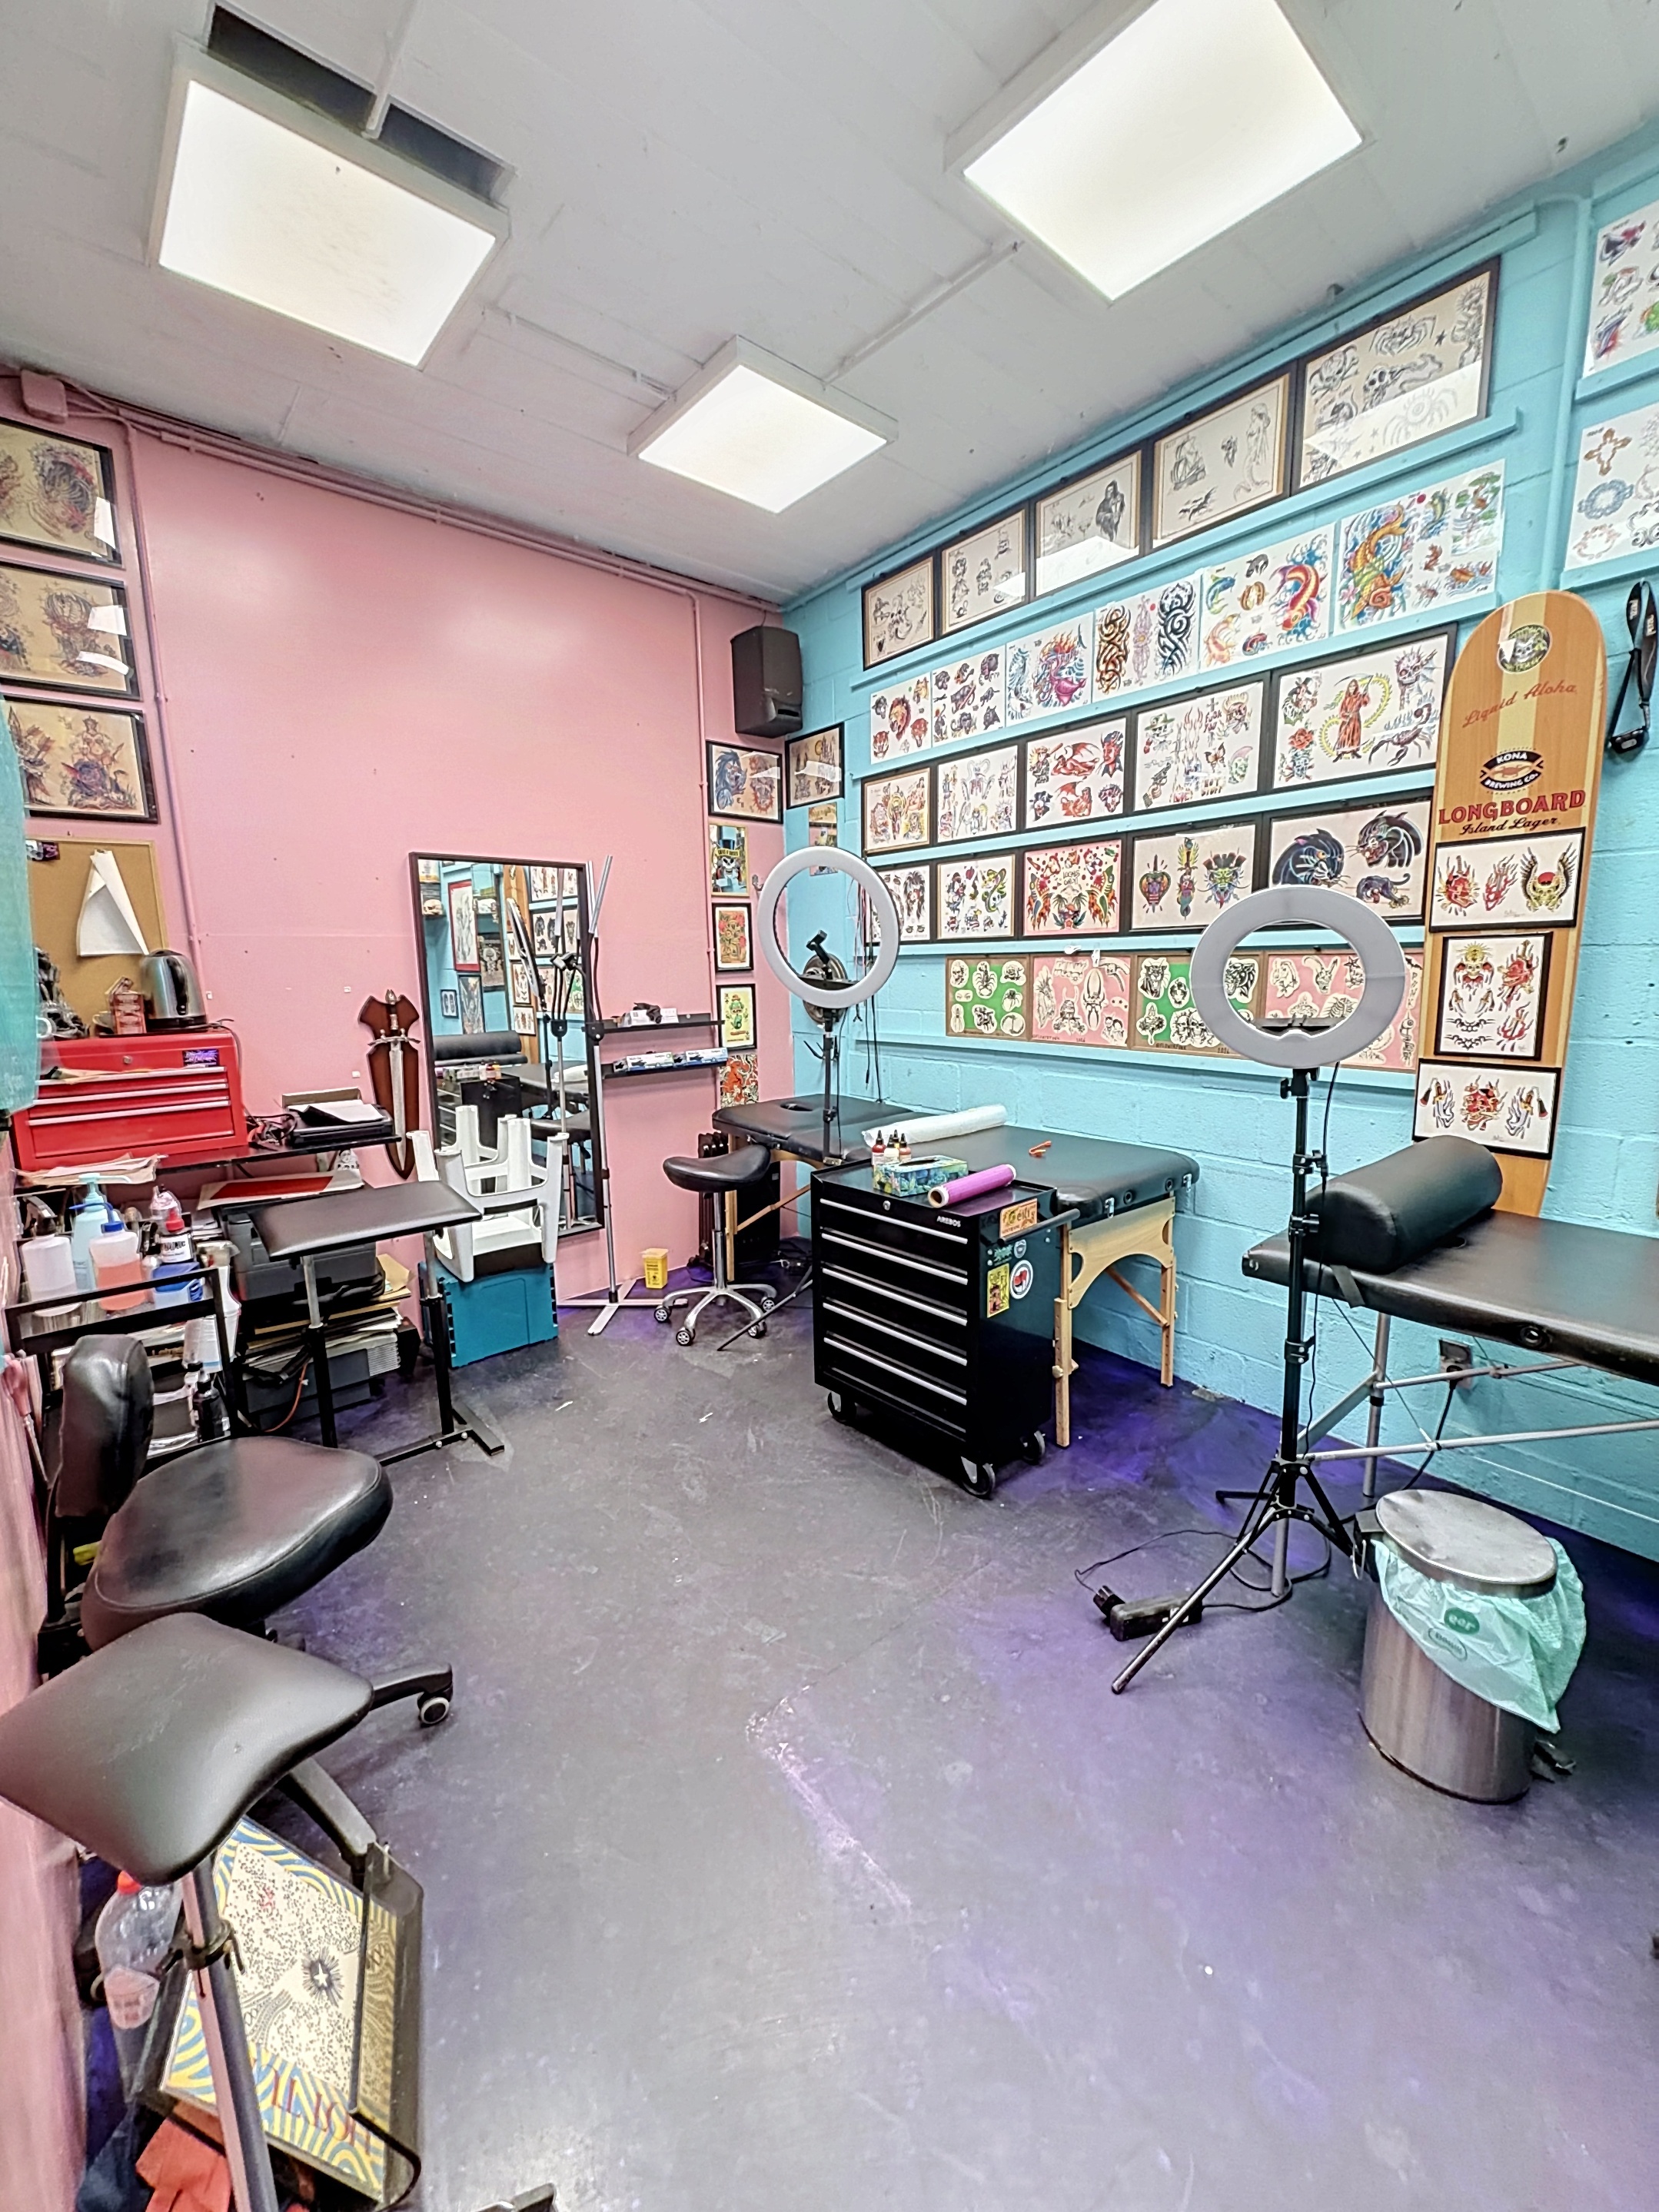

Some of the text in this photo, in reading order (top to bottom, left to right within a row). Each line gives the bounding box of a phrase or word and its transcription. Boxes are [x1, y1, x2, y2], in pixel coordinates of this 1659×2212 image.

[1462, 679, 1576, 729] Liquid Aloha
[1496, 752, 1528, 764] KONA
[1484, 779, 1524, 789] BREWING
[1438, 789, 1586, 825] LONGBOARD
[1459, 816, 1558, 835] Island Lager
[936, 1215, 961, 1227] AREBOS
